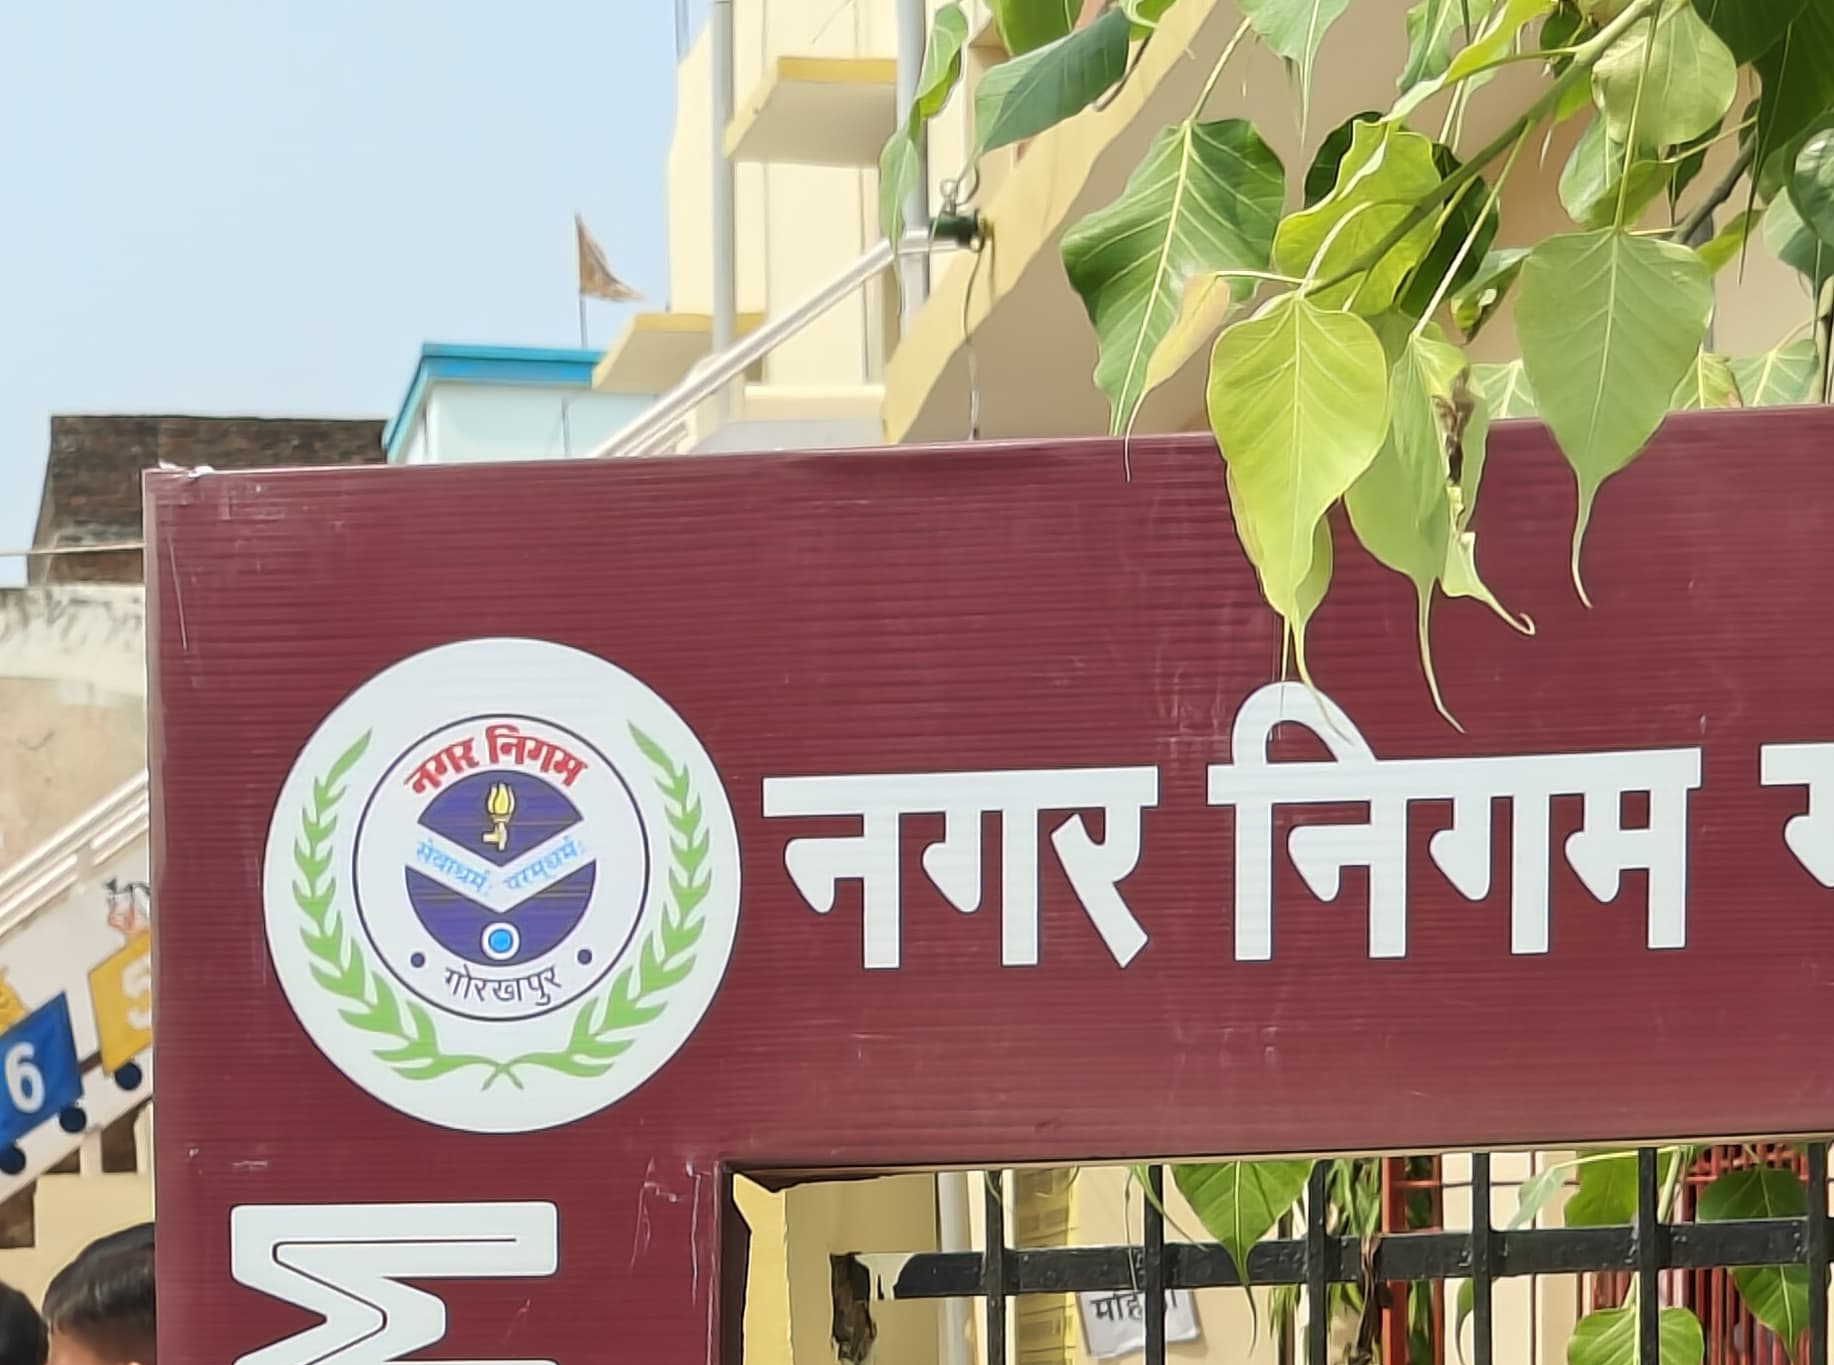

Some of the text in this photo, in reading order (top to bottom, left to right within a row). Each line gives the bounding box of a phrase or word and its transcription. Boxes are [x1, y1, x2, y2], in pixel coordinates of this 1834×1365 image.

[404, 724, 588, 794] नगर निगम
[763, 765, 1158, 968] नगर
[1207, 681, 1702, 961] निगम
[445, 965, 561, 1006] गोरखपुर
[4, 1042, 45, 1114] 6
